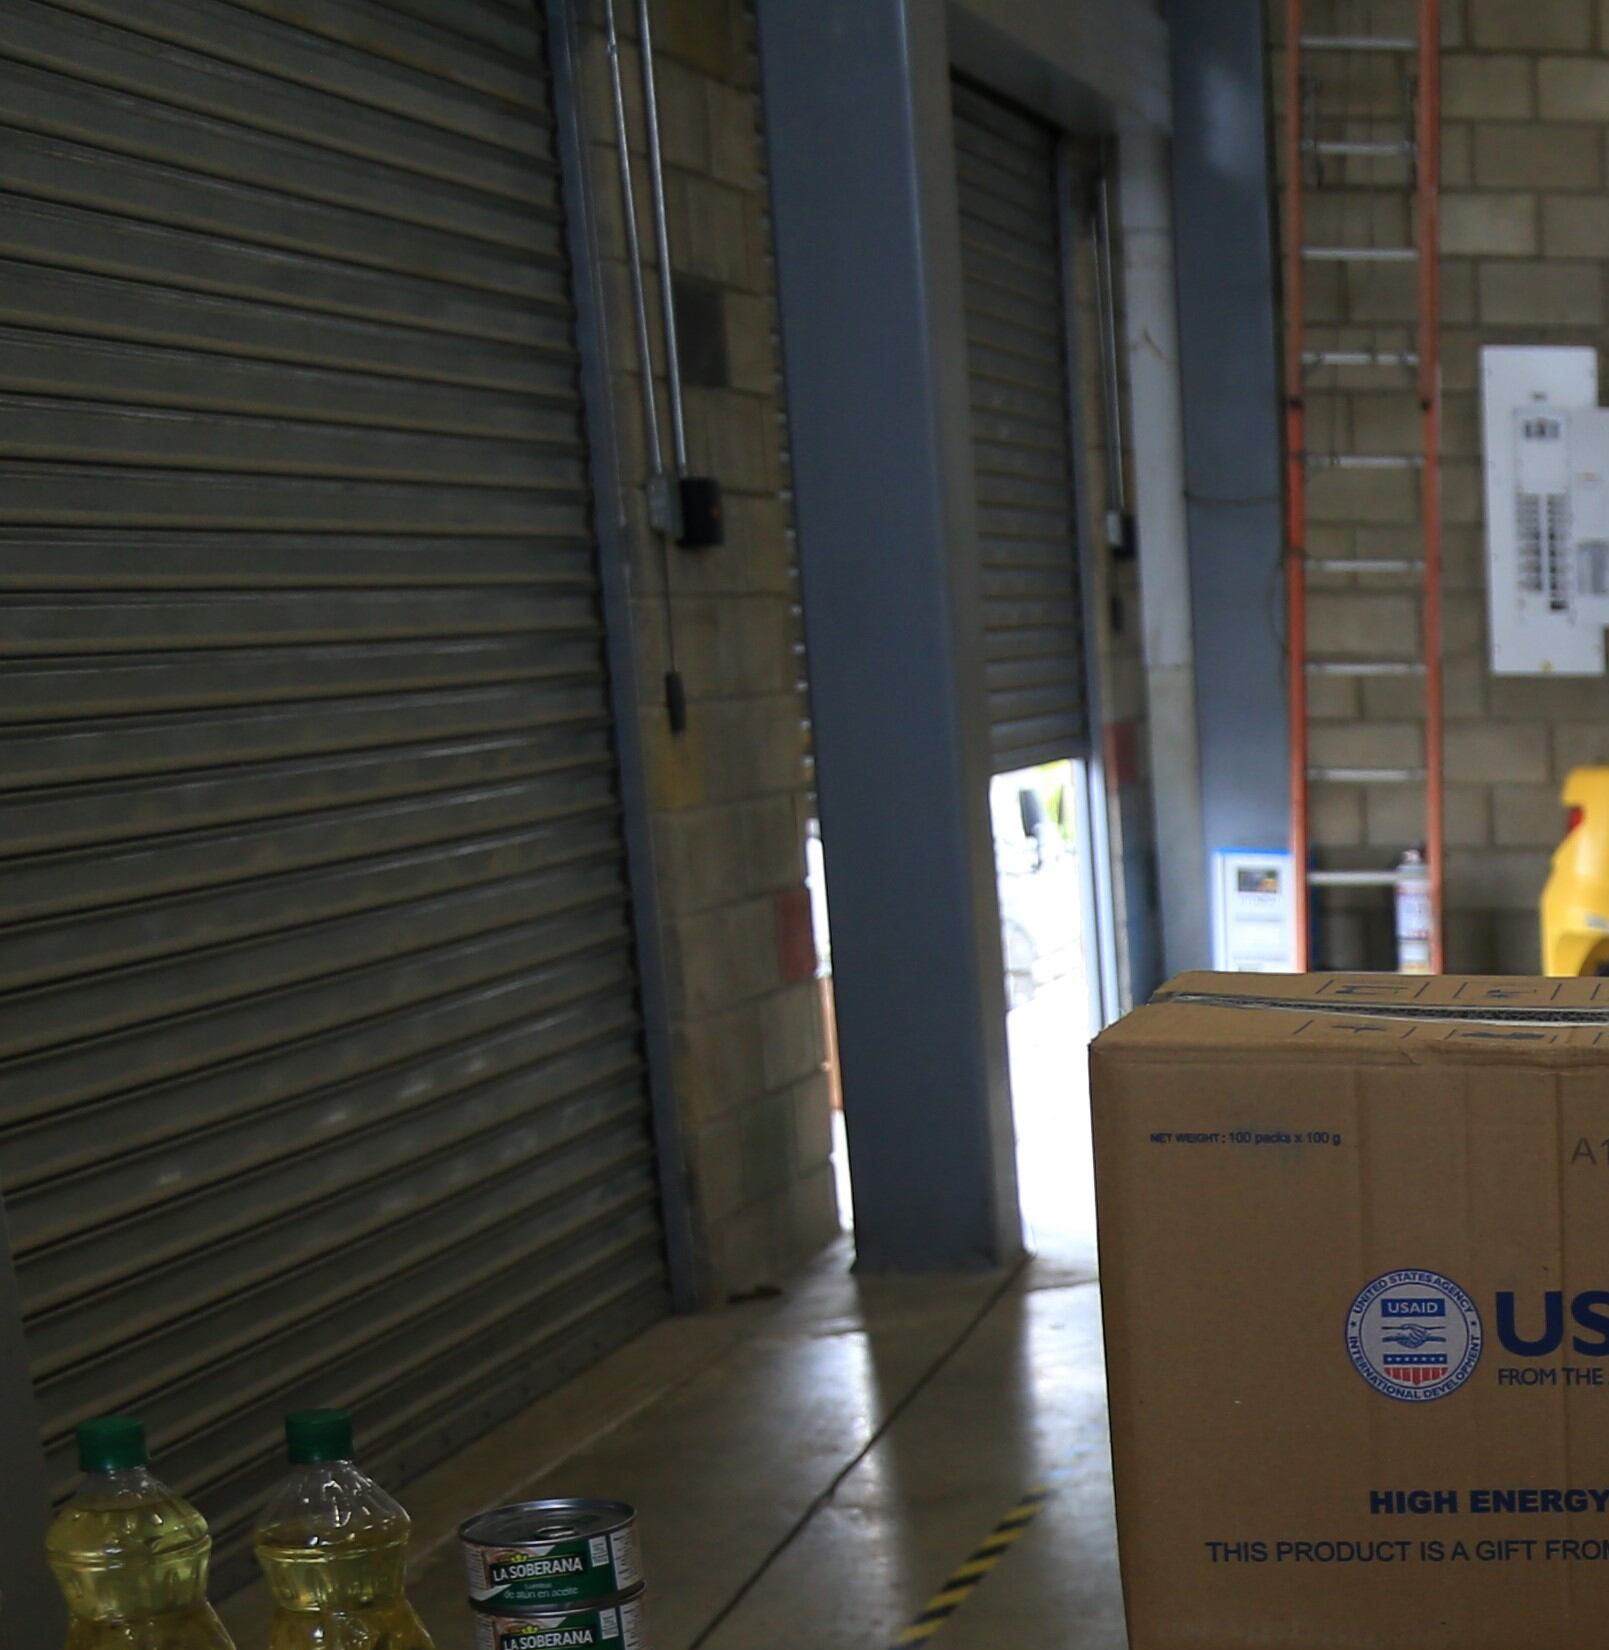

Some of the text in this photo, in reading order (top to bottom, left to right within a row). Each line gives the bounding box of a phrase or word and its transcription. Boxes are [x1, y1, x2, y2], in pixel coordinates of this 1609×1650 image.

[1387, 1302, 1438, 1314] USAID
[1497, 1367, 1556, 1386] FROM
[1560, 1366, 1603, 1387] THE
[1369, 1489, 1458, 1514] HIGH
[1204, 1541, 1268, 1562] THIS
[1276, 1540, 1412, 1562] PRODUCT
[1419, 1540, 1445, 1562] IS
[1450, 1540, 1470, 1561] A
[1475, 1539, 1537, 1561] GIFT
[493, 1557, 583, 1582] LA SOBERANA
[503, 1630, 593, 1650] LA SOBERANA
